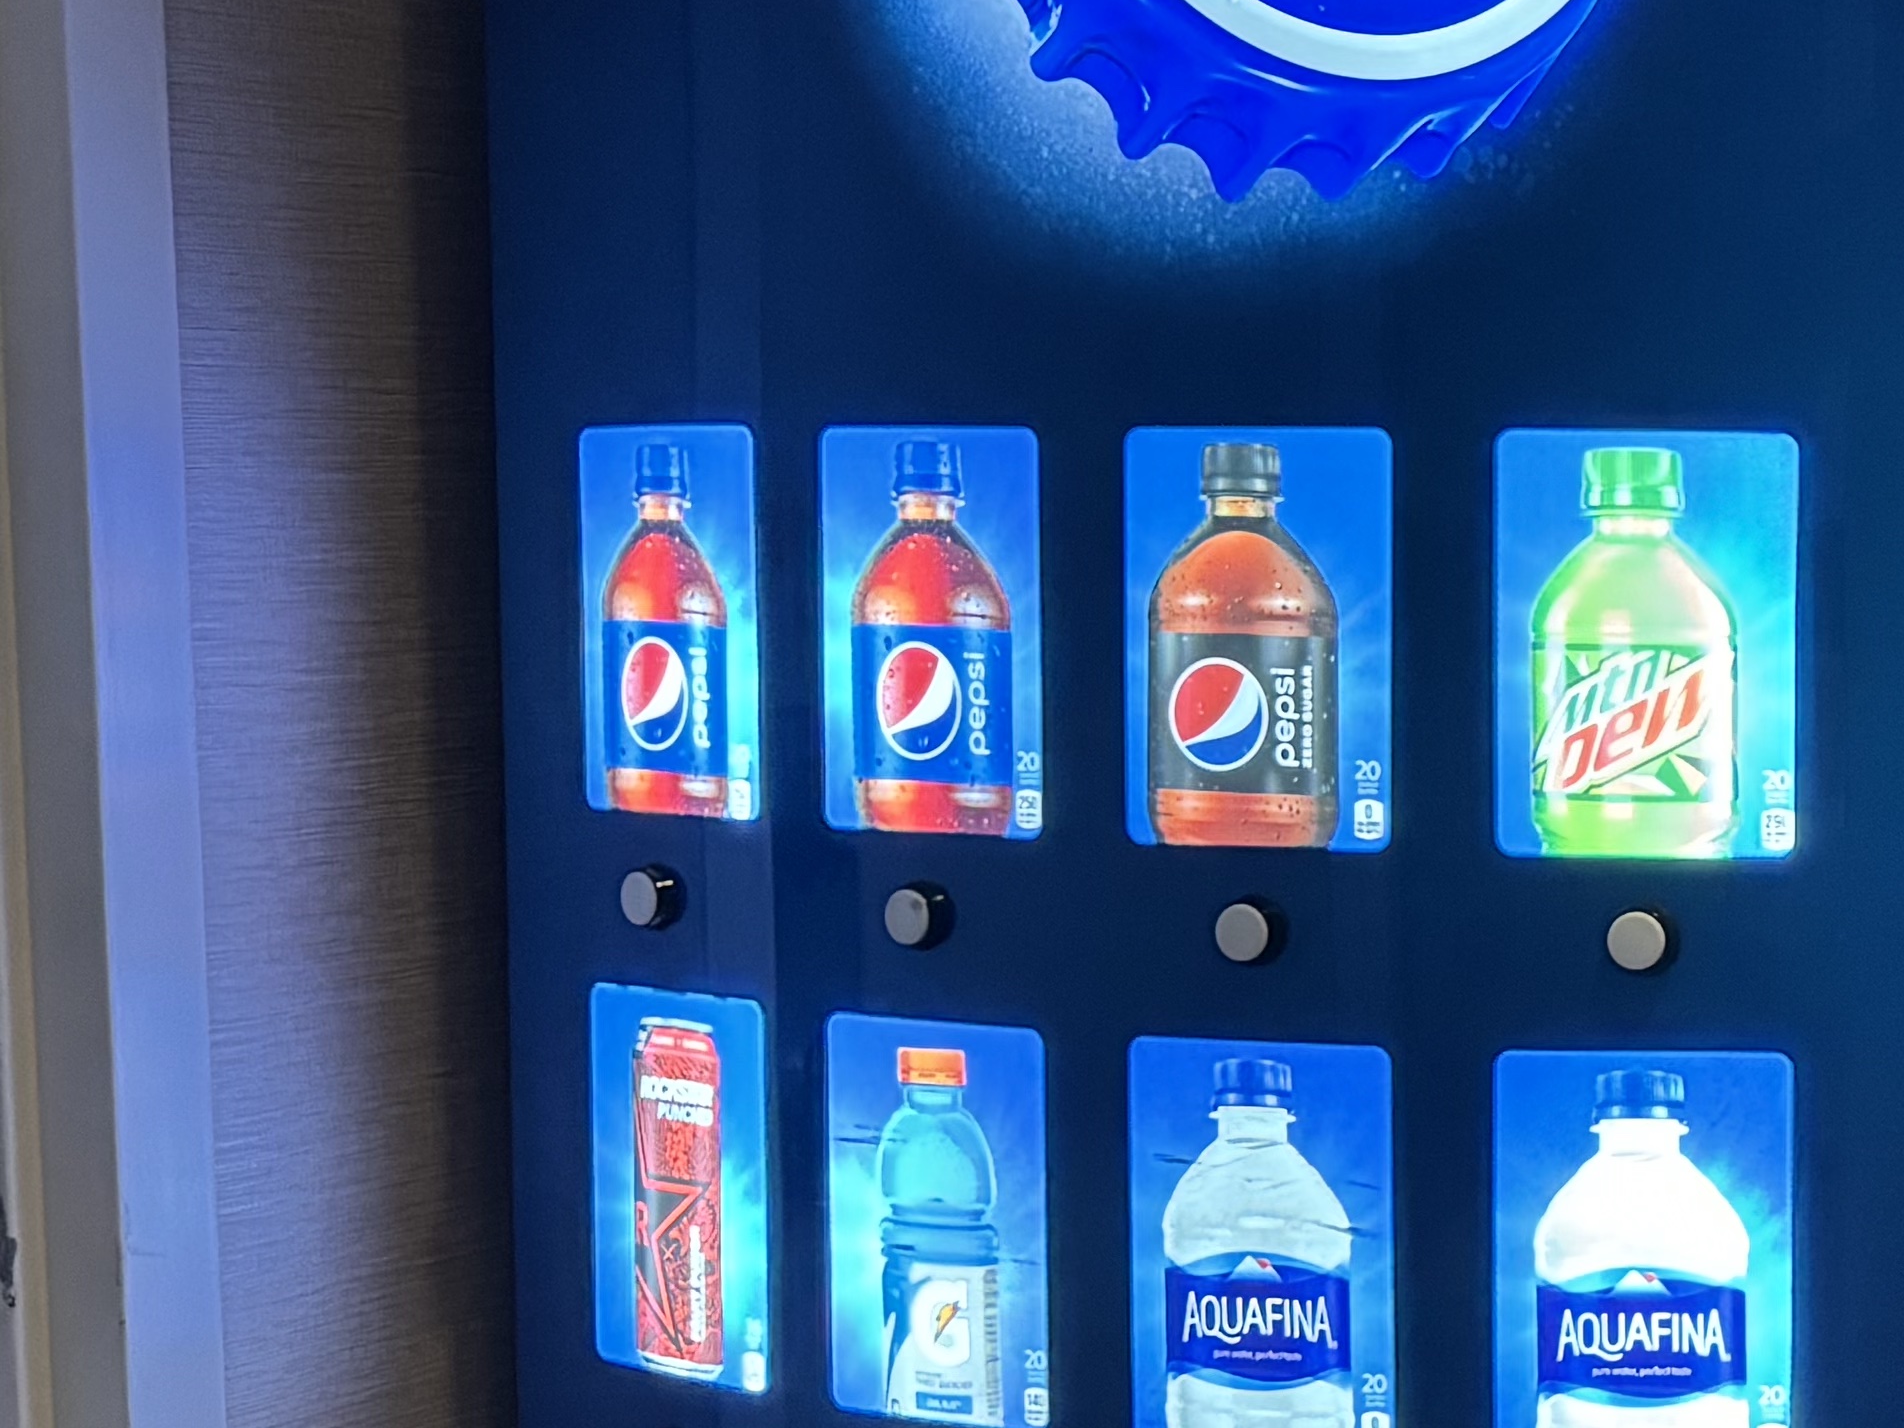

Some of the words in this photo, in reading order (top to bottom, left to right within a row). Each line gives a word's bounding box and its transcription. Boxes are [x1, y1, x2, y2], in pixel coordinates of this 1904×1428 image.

[688, 646, 711, 750] pepsi
[963, 651, 991, 756] pepsi
[1270, 668, 1300, 767] pepsi
[1017, 750, 1040, 771] 20
[1302, 724, 1313, 769] ZERO
[1355, 760, 1381, 781] 20
[1762, 769, 1792, 791] 20
[1182, 1291, 1333, 1349] AQUAFINA
[1557, 1308, 1730, 1363] AQUAFINA
[1024, 1349, 1047, 1370] 20
[1362, 1373, 1387, 1394] 20
[1758, 1384, 1785, 1406] 20
